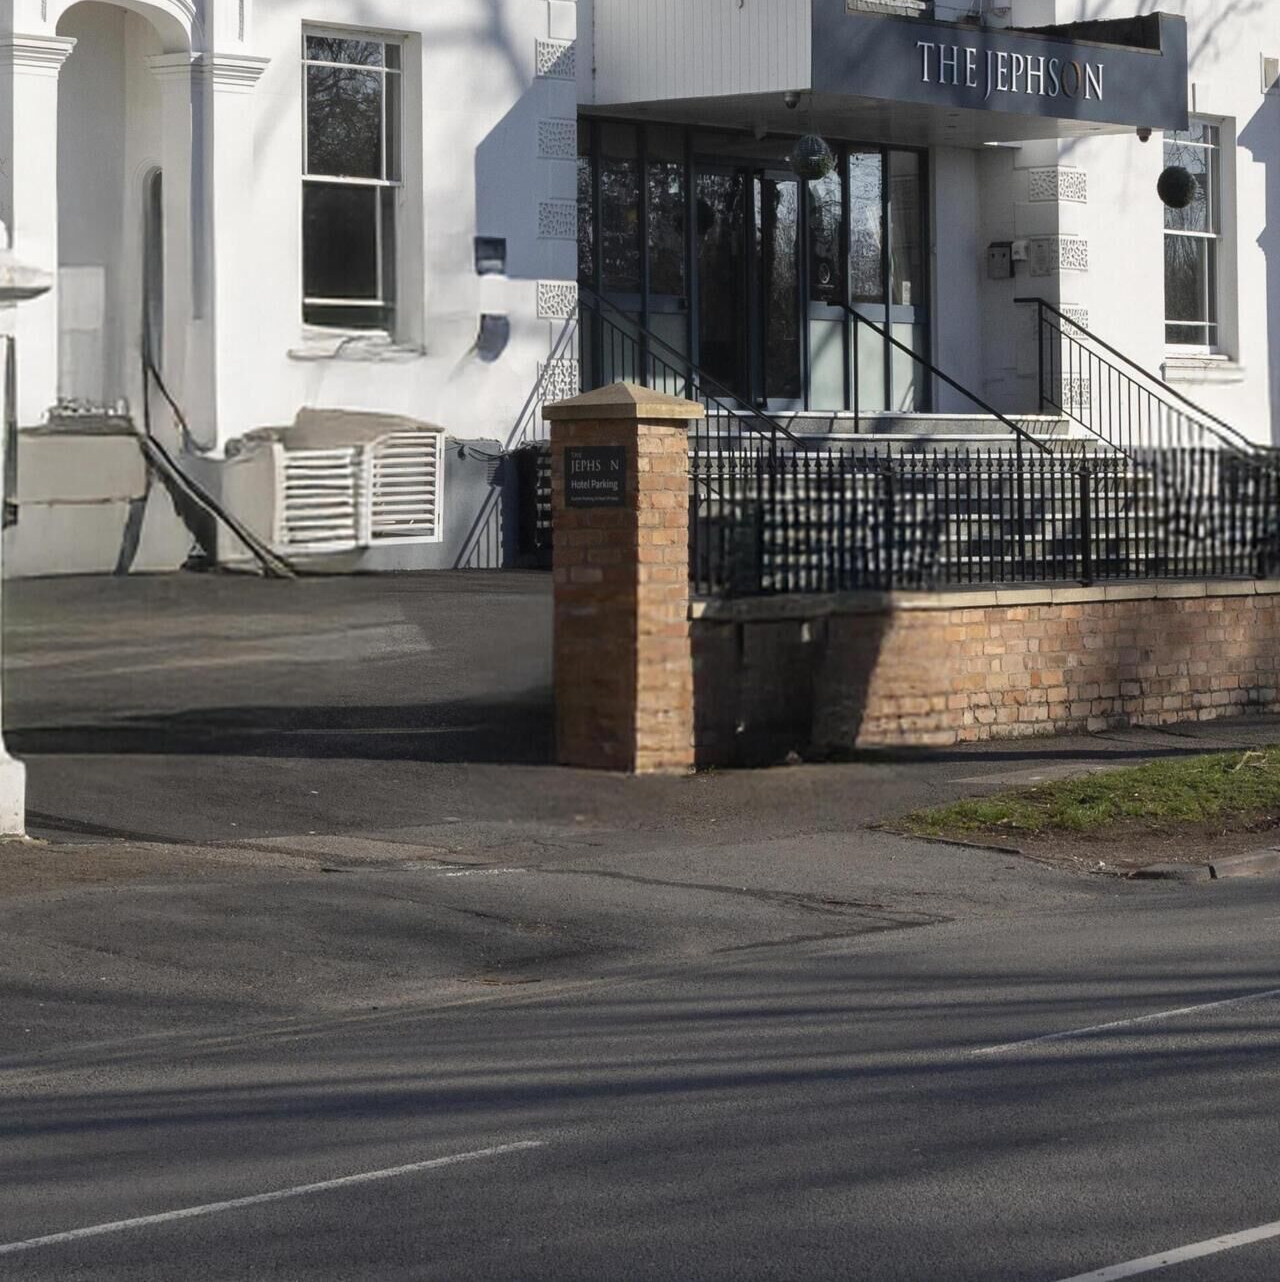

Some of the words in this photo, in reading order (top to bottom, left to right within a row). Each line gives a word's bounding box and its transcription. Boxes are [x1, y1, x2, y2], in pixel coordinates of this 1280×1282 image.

[917, 41, 977, 88] THE
[984, 50, 1105, 101] JEPHSON
[571, 459, 619, 475] JEPHSN
[571, 478, 590, 490] Hotel
[591, 478, 619, 492] Parking
